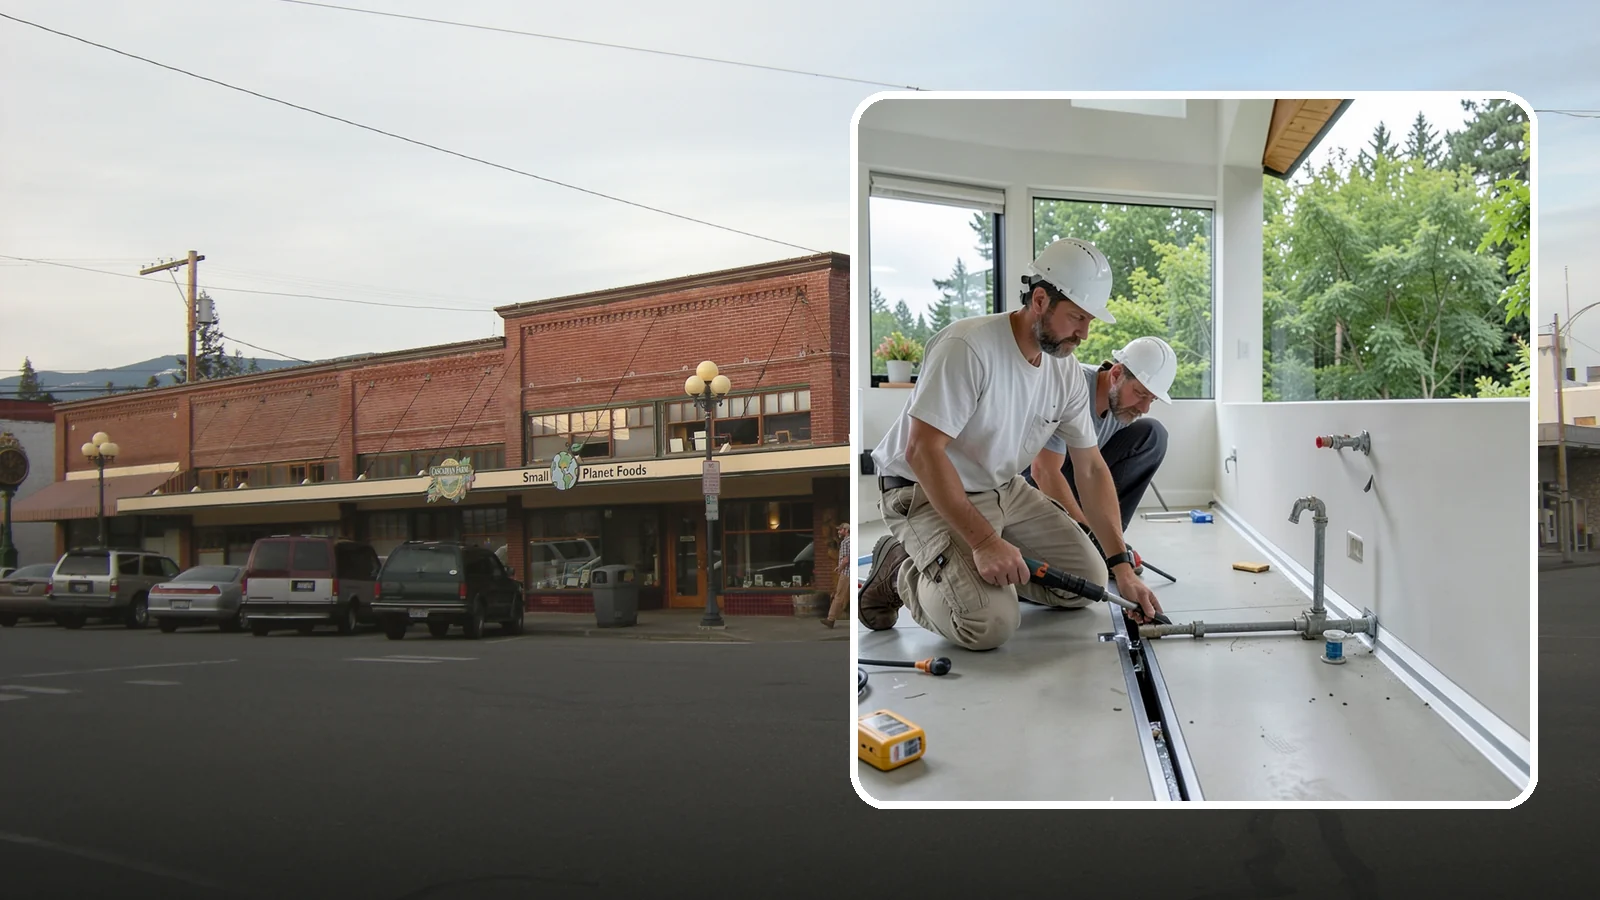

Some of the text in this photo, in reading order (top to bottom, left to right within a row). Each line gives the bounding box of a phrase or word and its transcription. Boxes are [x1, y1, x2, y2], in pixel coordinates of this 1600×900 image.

[523, 464, 647, 483] Small Planet Foods
